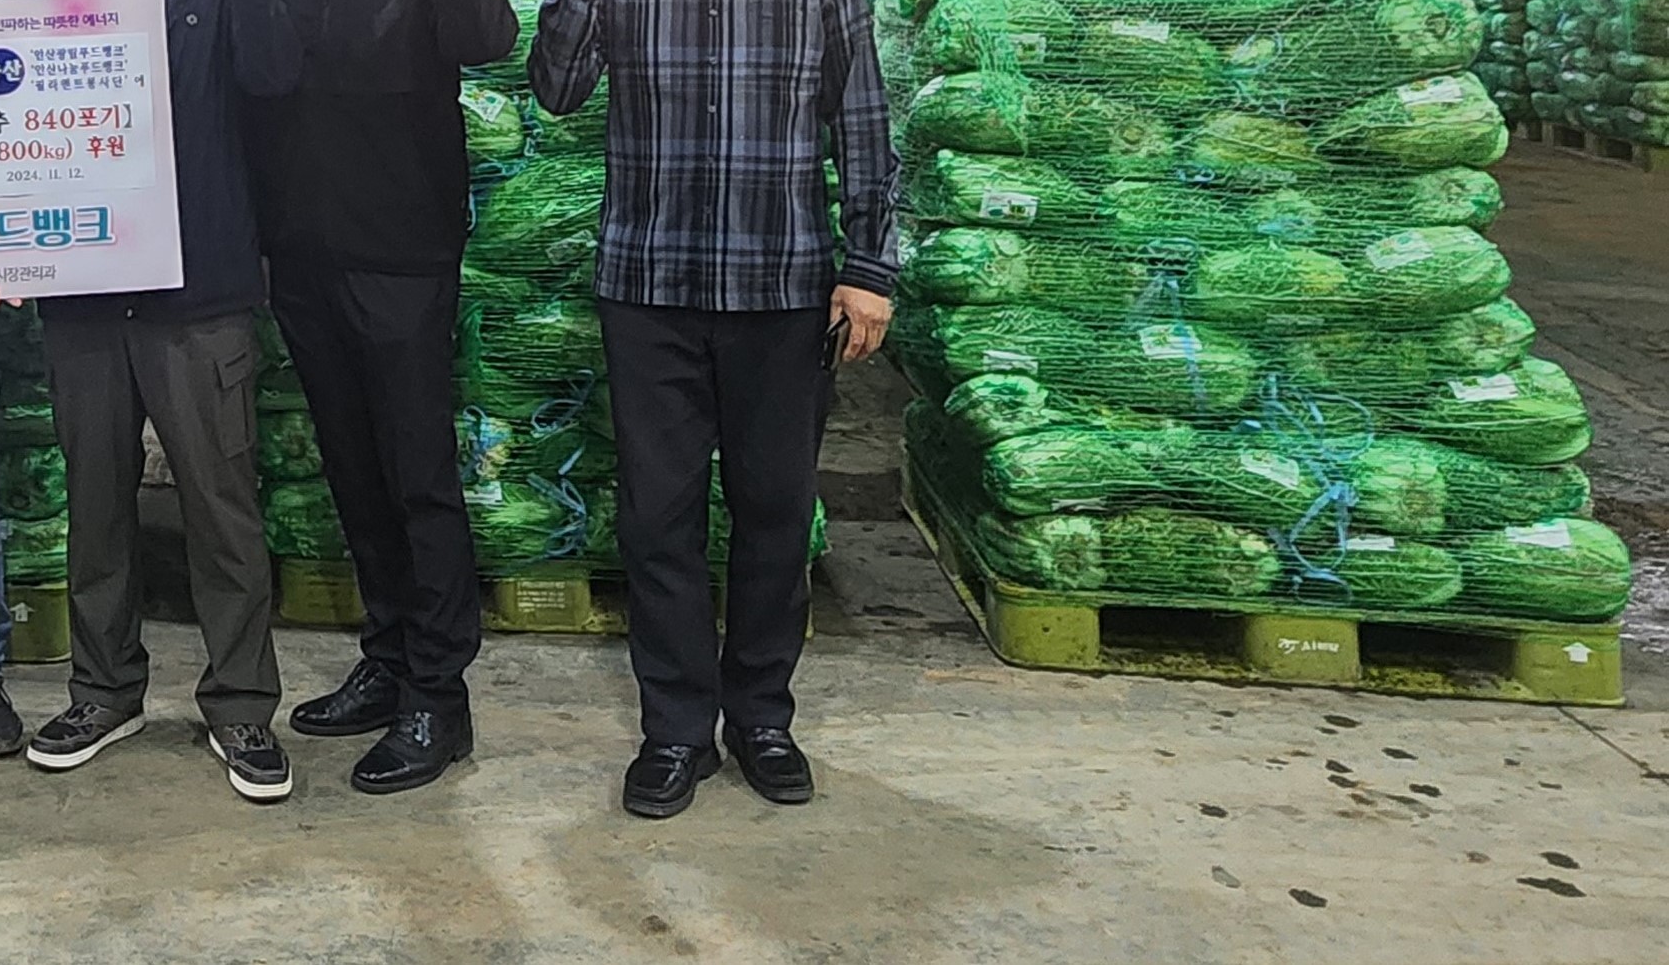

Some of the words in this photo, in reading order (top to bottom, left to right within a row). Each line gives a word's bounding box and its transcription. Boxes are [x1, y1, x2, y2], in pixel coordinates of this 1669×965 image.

[43, 14, 80, 30] 따뜻한
[83, 11, 119, 27] 에너지
[86, 135, 126, 159] 후원
[6, 170, 42, 182] 2024.
